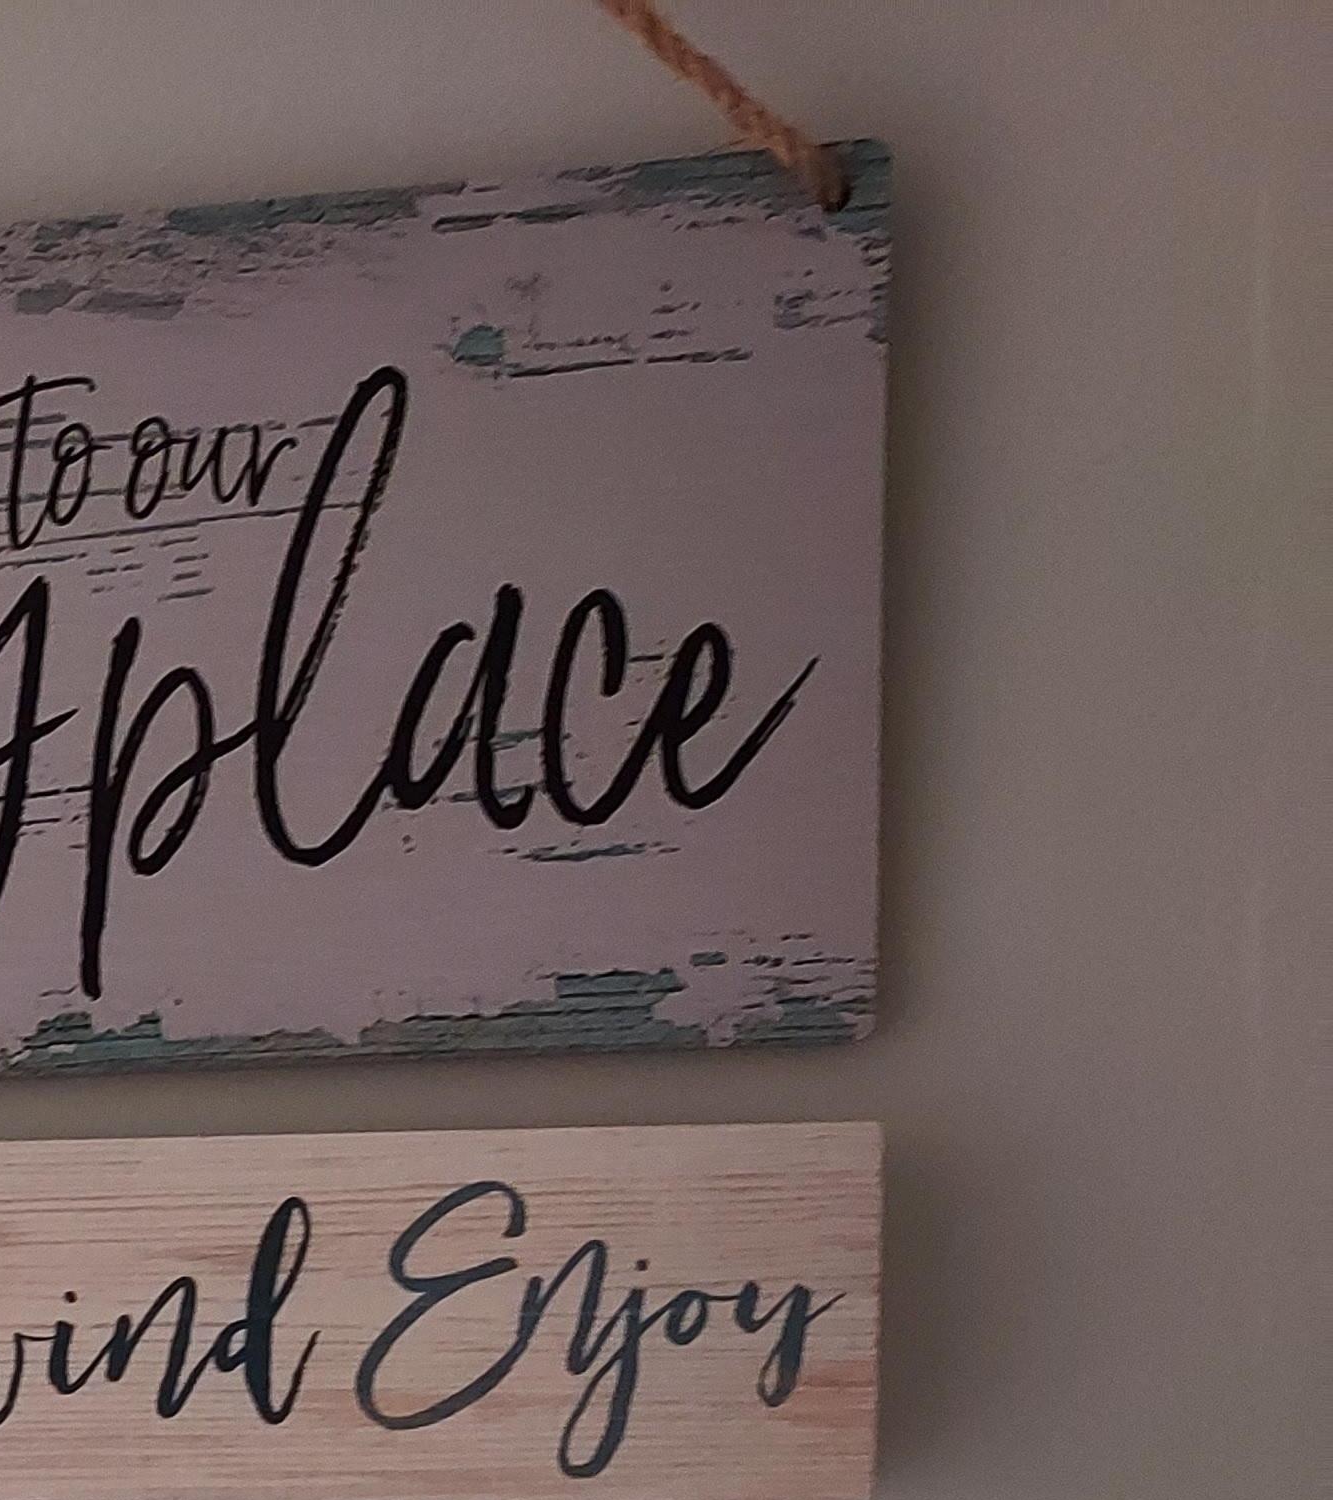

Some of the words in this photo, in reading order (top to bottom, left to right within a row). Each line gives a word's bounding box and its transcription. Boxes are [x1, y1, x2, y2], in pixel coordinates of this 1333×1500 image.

[126, 415, 299, 519] our
[83, 367, 818, 998] place
[357, 1181, 846, 1477] Enjoy
